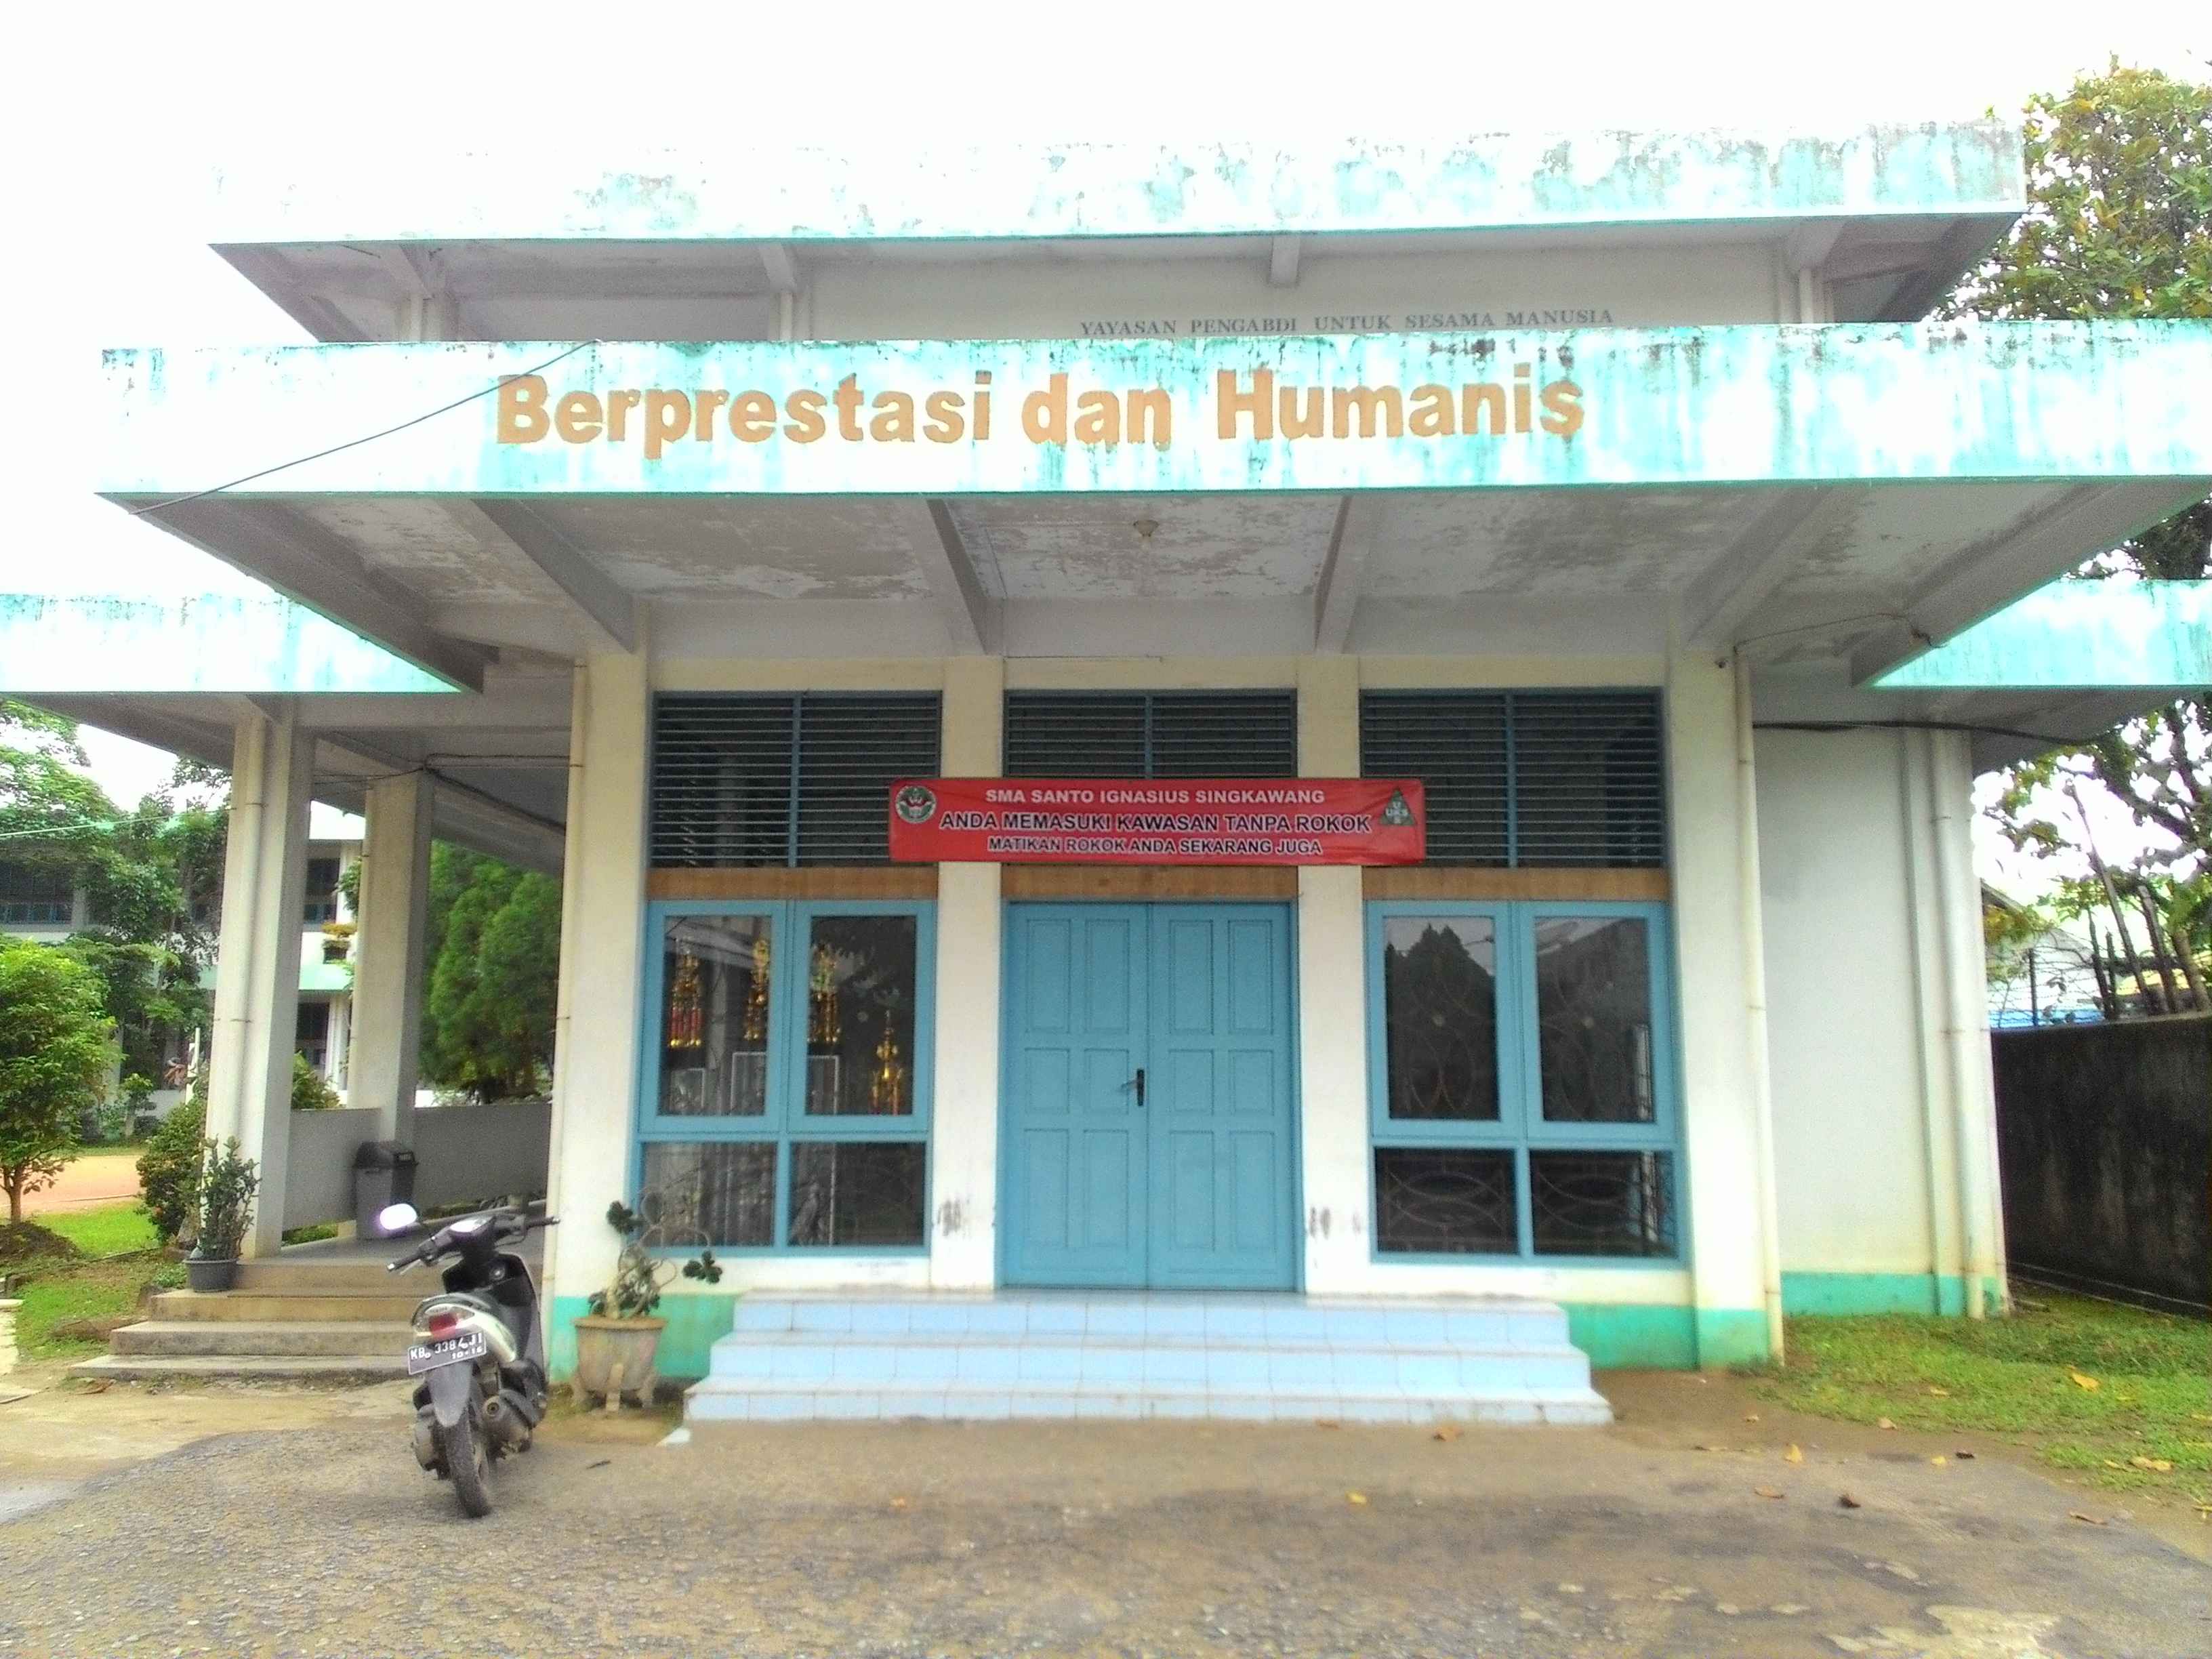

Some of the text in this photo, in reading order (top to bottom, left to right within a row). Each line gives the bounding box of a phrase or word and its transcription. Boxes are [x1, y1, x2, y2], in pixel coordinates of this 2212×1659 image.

[1081, 310, 1614, 335] YAYASAN PENGABDI UNTUK SESAMA MANUSIA
[496, 361, 1584, 460] Berprestasi dan Humanis
[985, 790, 1325, 804] SMA SANTO IGNASIUS SINGKAWANG
[939, 811, 1372, 834] ANDA MEMASUKI KAWASAN TANPA ROKOK
[987, 836, 1323, 855] MATIKAN ROKOK ANDA SEKARANG JUGA
[410, 1347, 425, 1359] KB
